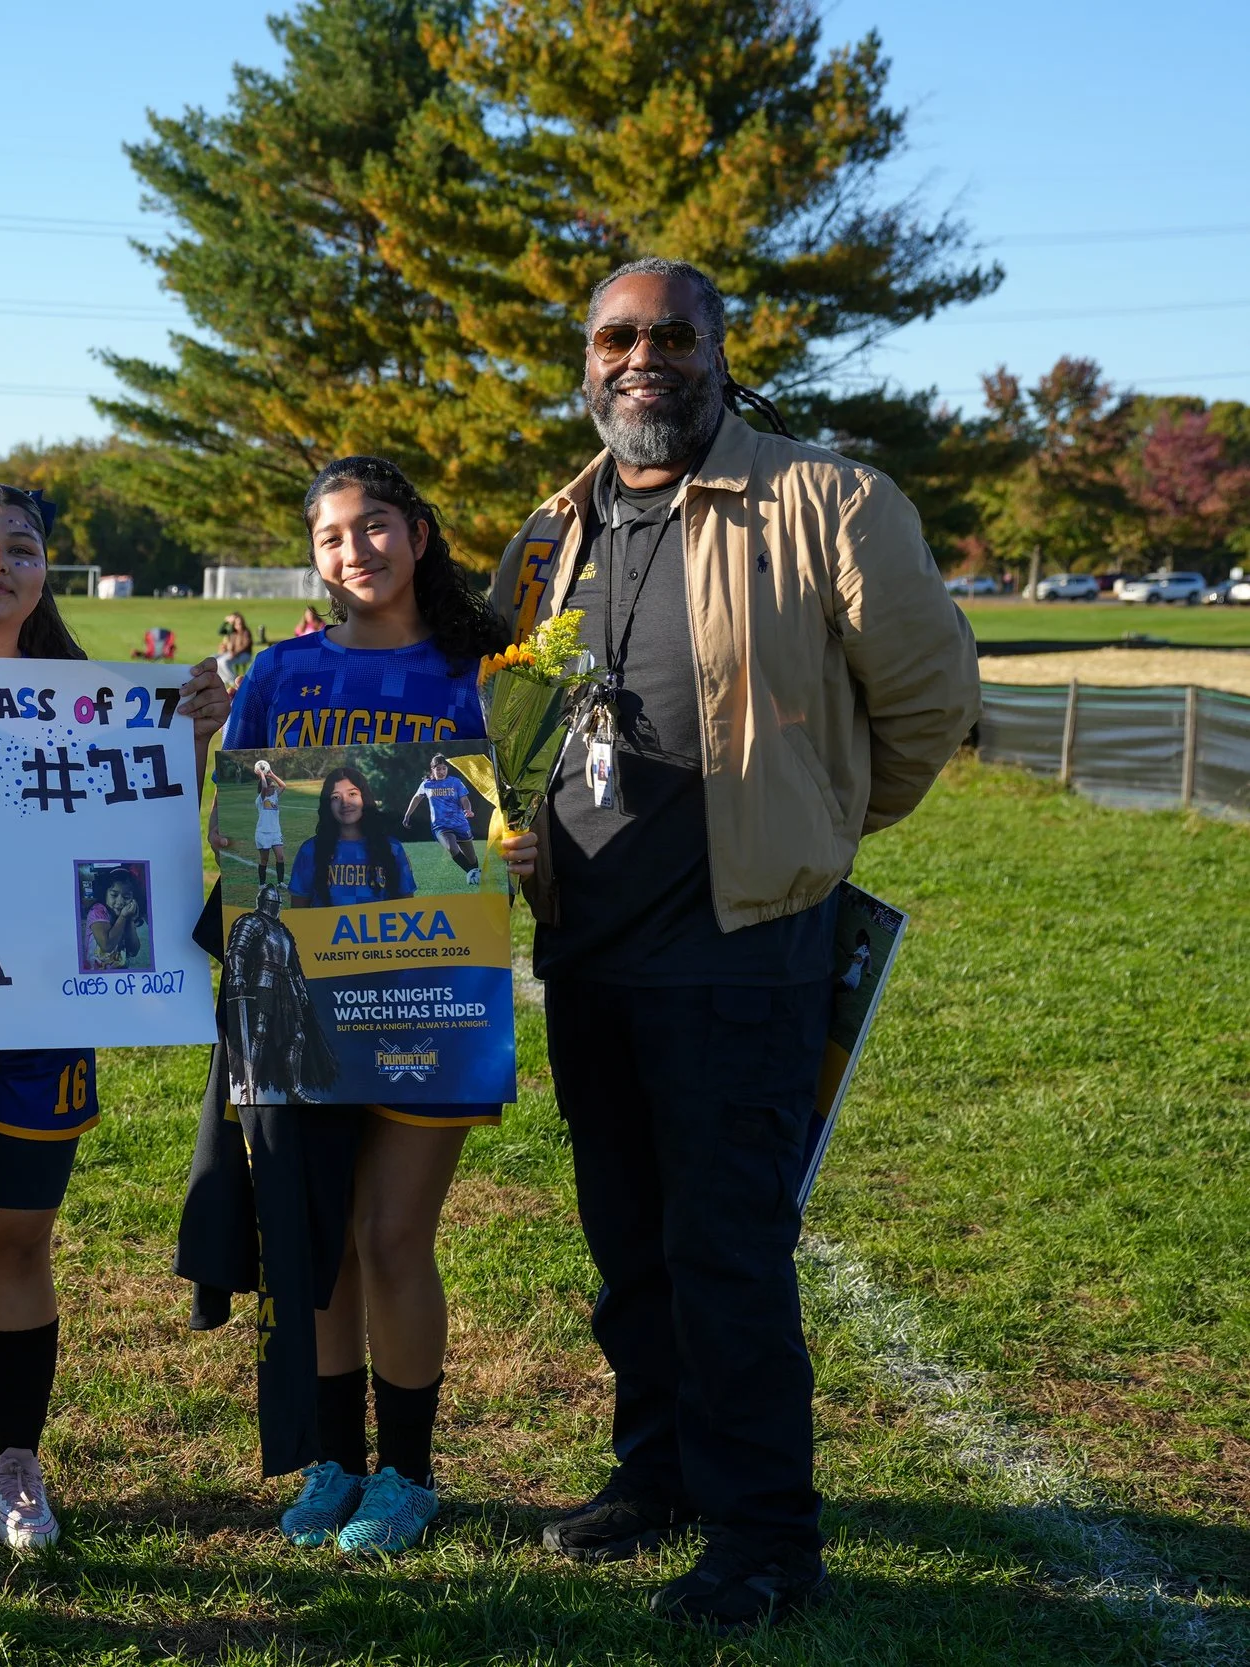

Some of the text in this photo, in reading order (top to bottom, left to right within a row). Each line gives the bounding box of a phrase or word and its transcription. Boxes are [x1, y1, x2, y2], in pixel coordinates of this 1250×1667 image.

[73, 686, 115, 725] of
[124, 686, 183, 729] 27
[21, 744, 184, 813] #11
[331, 910, 456, 945] ALEXA
[314, 946, 470, 962] VARSITY GIRLS SOCCER 2026
[141, 969, 184, 995] 2027
[333, 987, 454, 1005] YOUR KNIGHTS
[334, 1002, 486, 1021] WATCH HAS ENDED
[336, 1020, 491, 1032] BUT ONCE A KNIGHT, ALWAYS A KNIGHT.
[377, 1051, 436, 1065] FOUNDATION
[53, 1058, 88, 1115] 16
